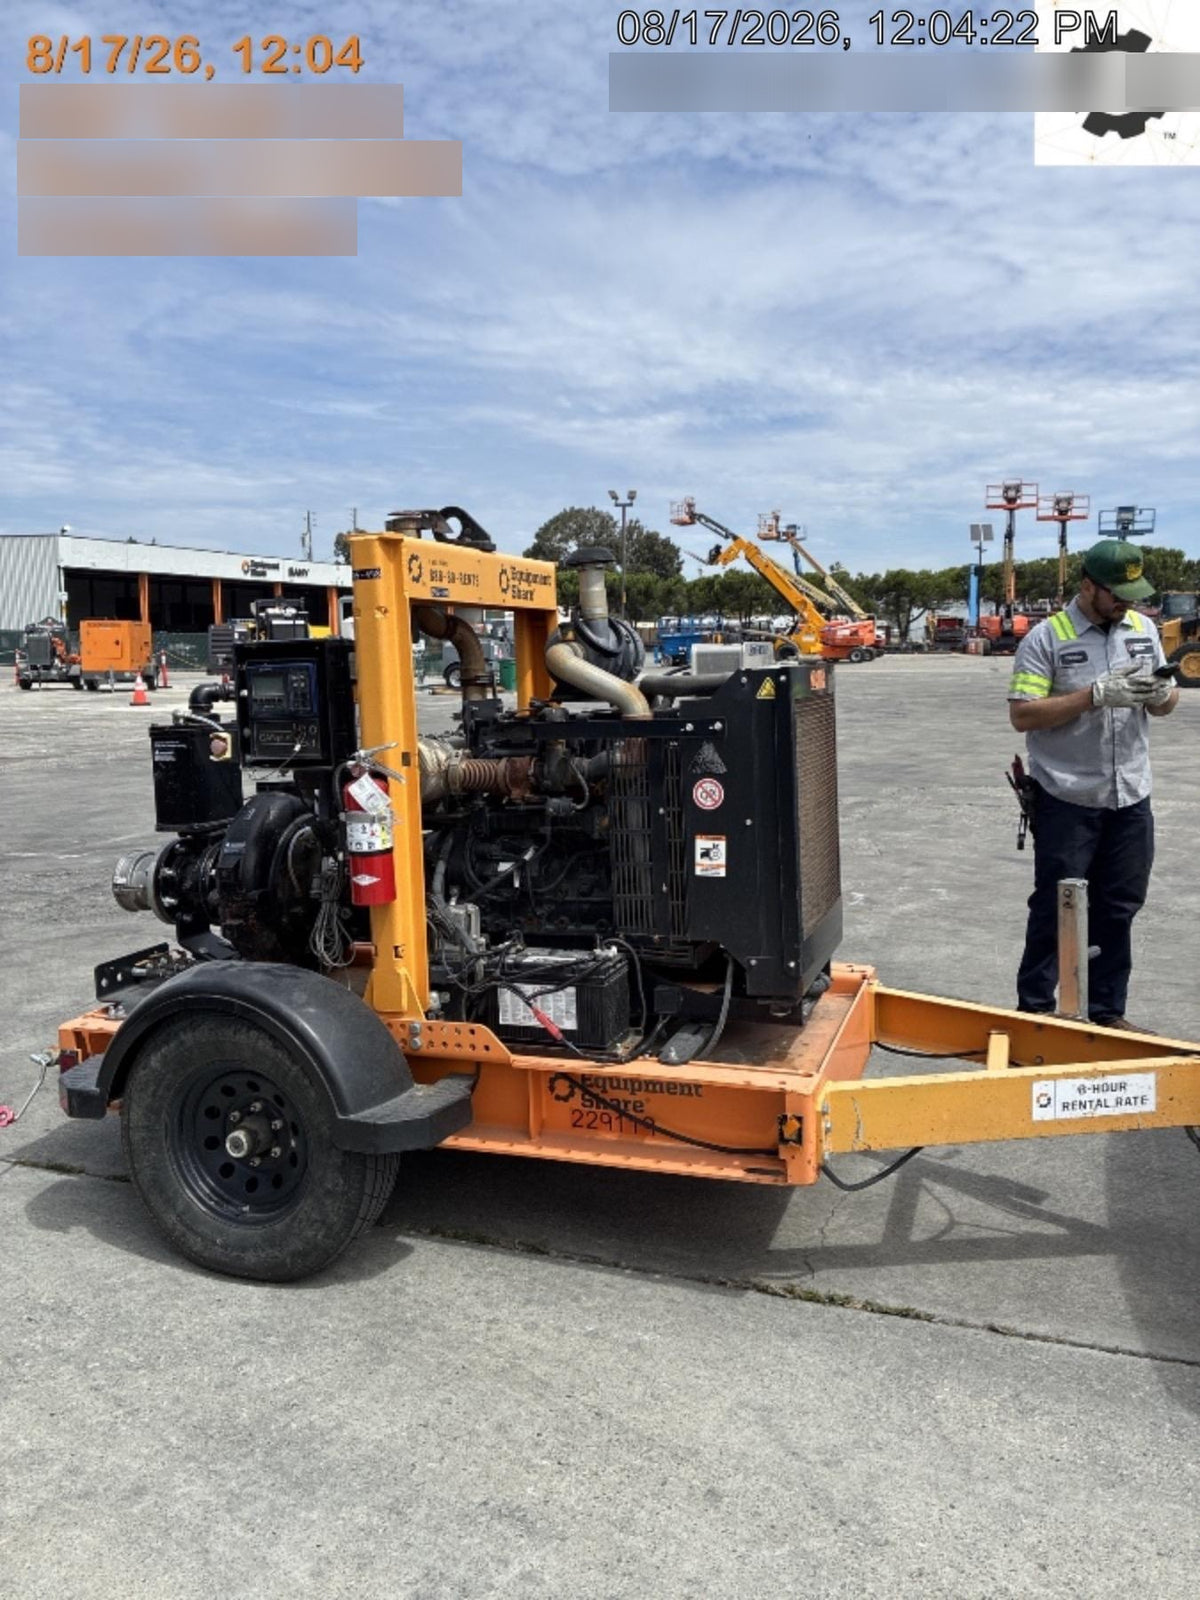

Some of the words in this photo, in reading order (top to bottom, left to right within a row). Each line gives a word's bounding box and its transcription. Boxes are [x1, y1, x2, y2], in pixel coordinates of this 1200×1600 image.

[580, 1074, 703, 1098] Equipment
[1062, 1098, 1111, 1112] RENTAL
[1115, 1095, 1149, 1108] RATE
